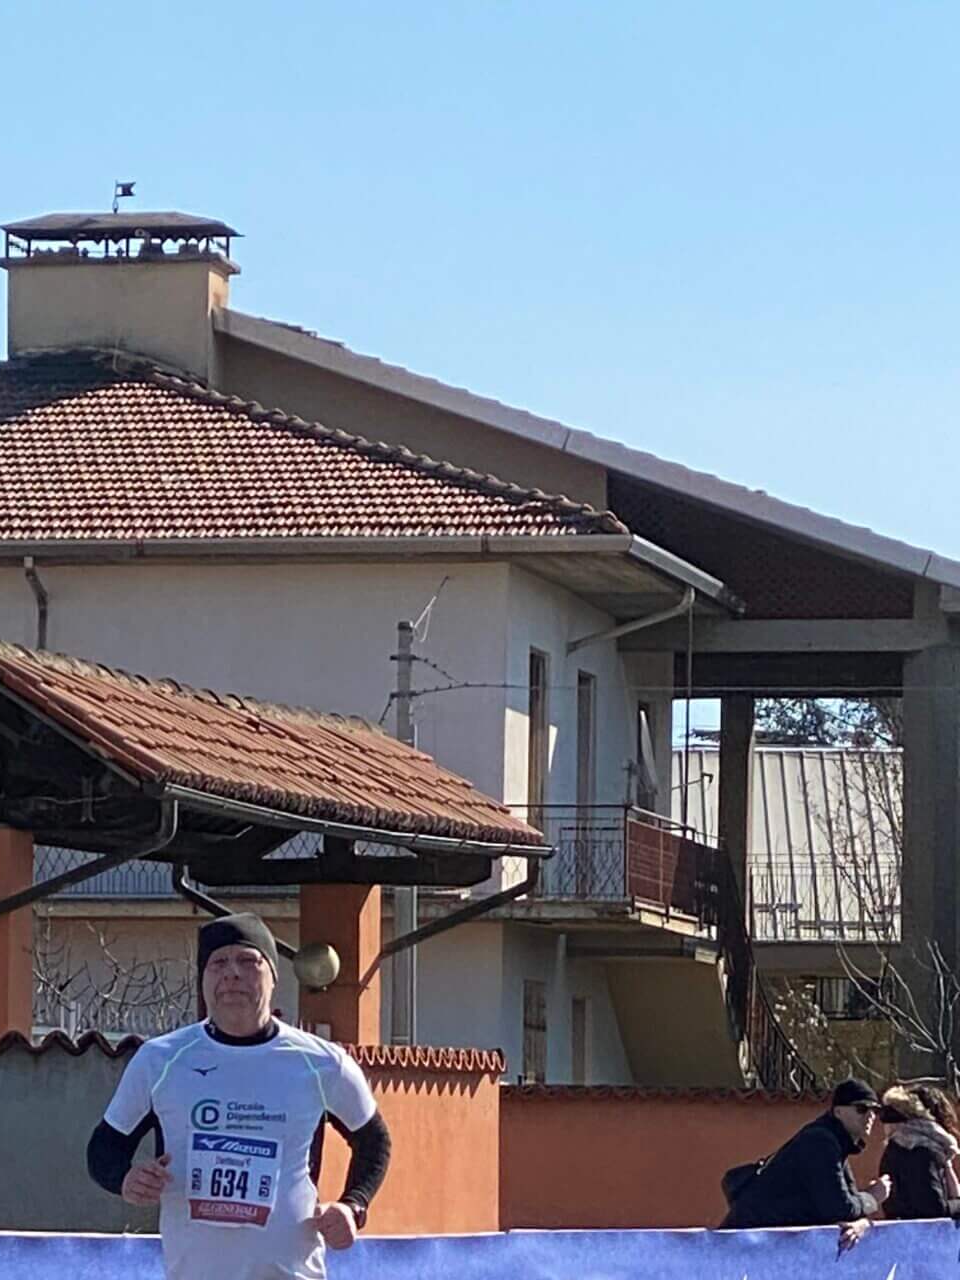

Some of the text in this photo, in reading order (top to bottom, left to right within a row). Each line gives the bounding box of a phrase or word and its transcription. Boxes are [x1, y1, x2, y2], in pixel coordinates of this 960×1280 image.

[227, 1101, 265, 1111] Circolo
[226, 1112, 287, 1123] Dipendenti
[210, 1167, 249, 1199] 634
